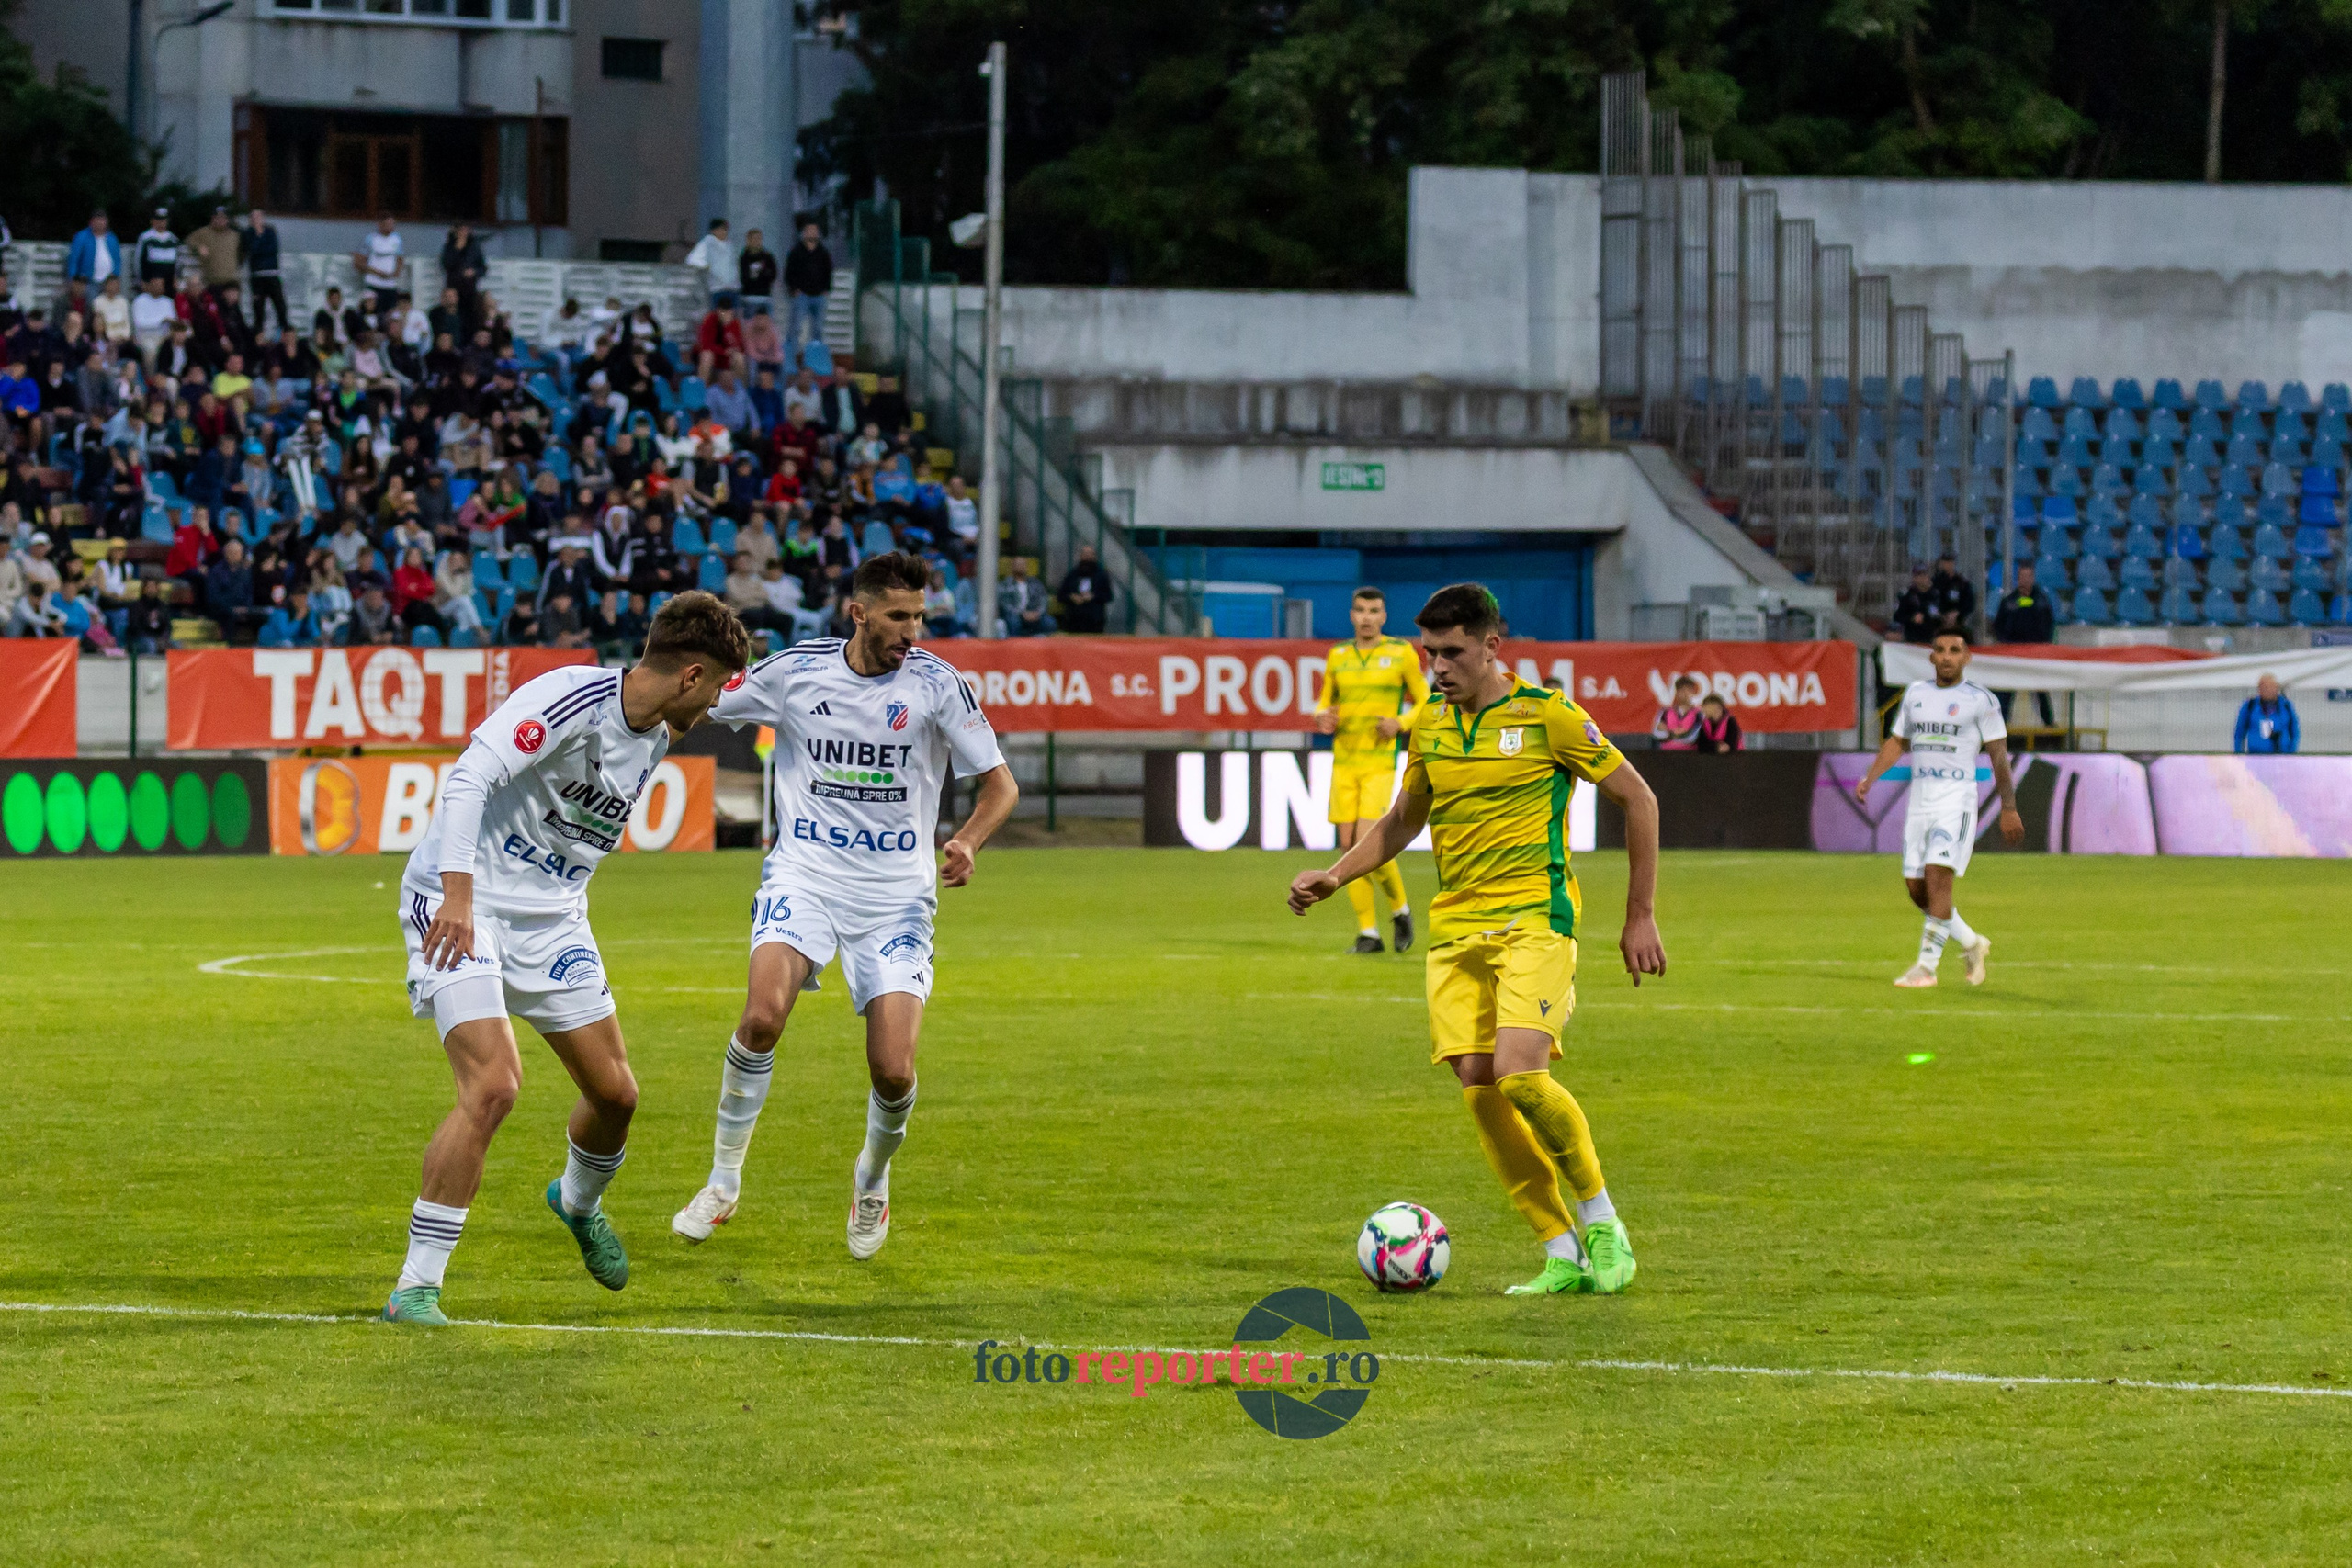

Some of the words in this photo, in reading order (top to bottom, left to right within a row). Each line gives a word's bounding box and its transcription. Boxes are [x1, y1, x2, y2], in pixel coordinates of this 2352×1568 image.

[253, 647, 485, 742] TAQT
[962, 670, 1093, 706] ORONA
[1110, 673, 1155, 698] S.C.
[1159, 655, 1574, 715] PRODM
[1580, 675, 1628, 700] S.A.
[1647, 669, 1826, 708] VORONA
[808, 738, 912, 768] UNIBET
[560, 781, 633, 823] UNIBE
[862, 790, 887, 801] SPRE
[794, 818, 917, 852] ELSACO
[503, 833, 592, 881] ELSAC
[761, 896, 792, 926] 16
[775, 926, 803, 942] Vestra
[552, 964, 565, 978] FIVE
